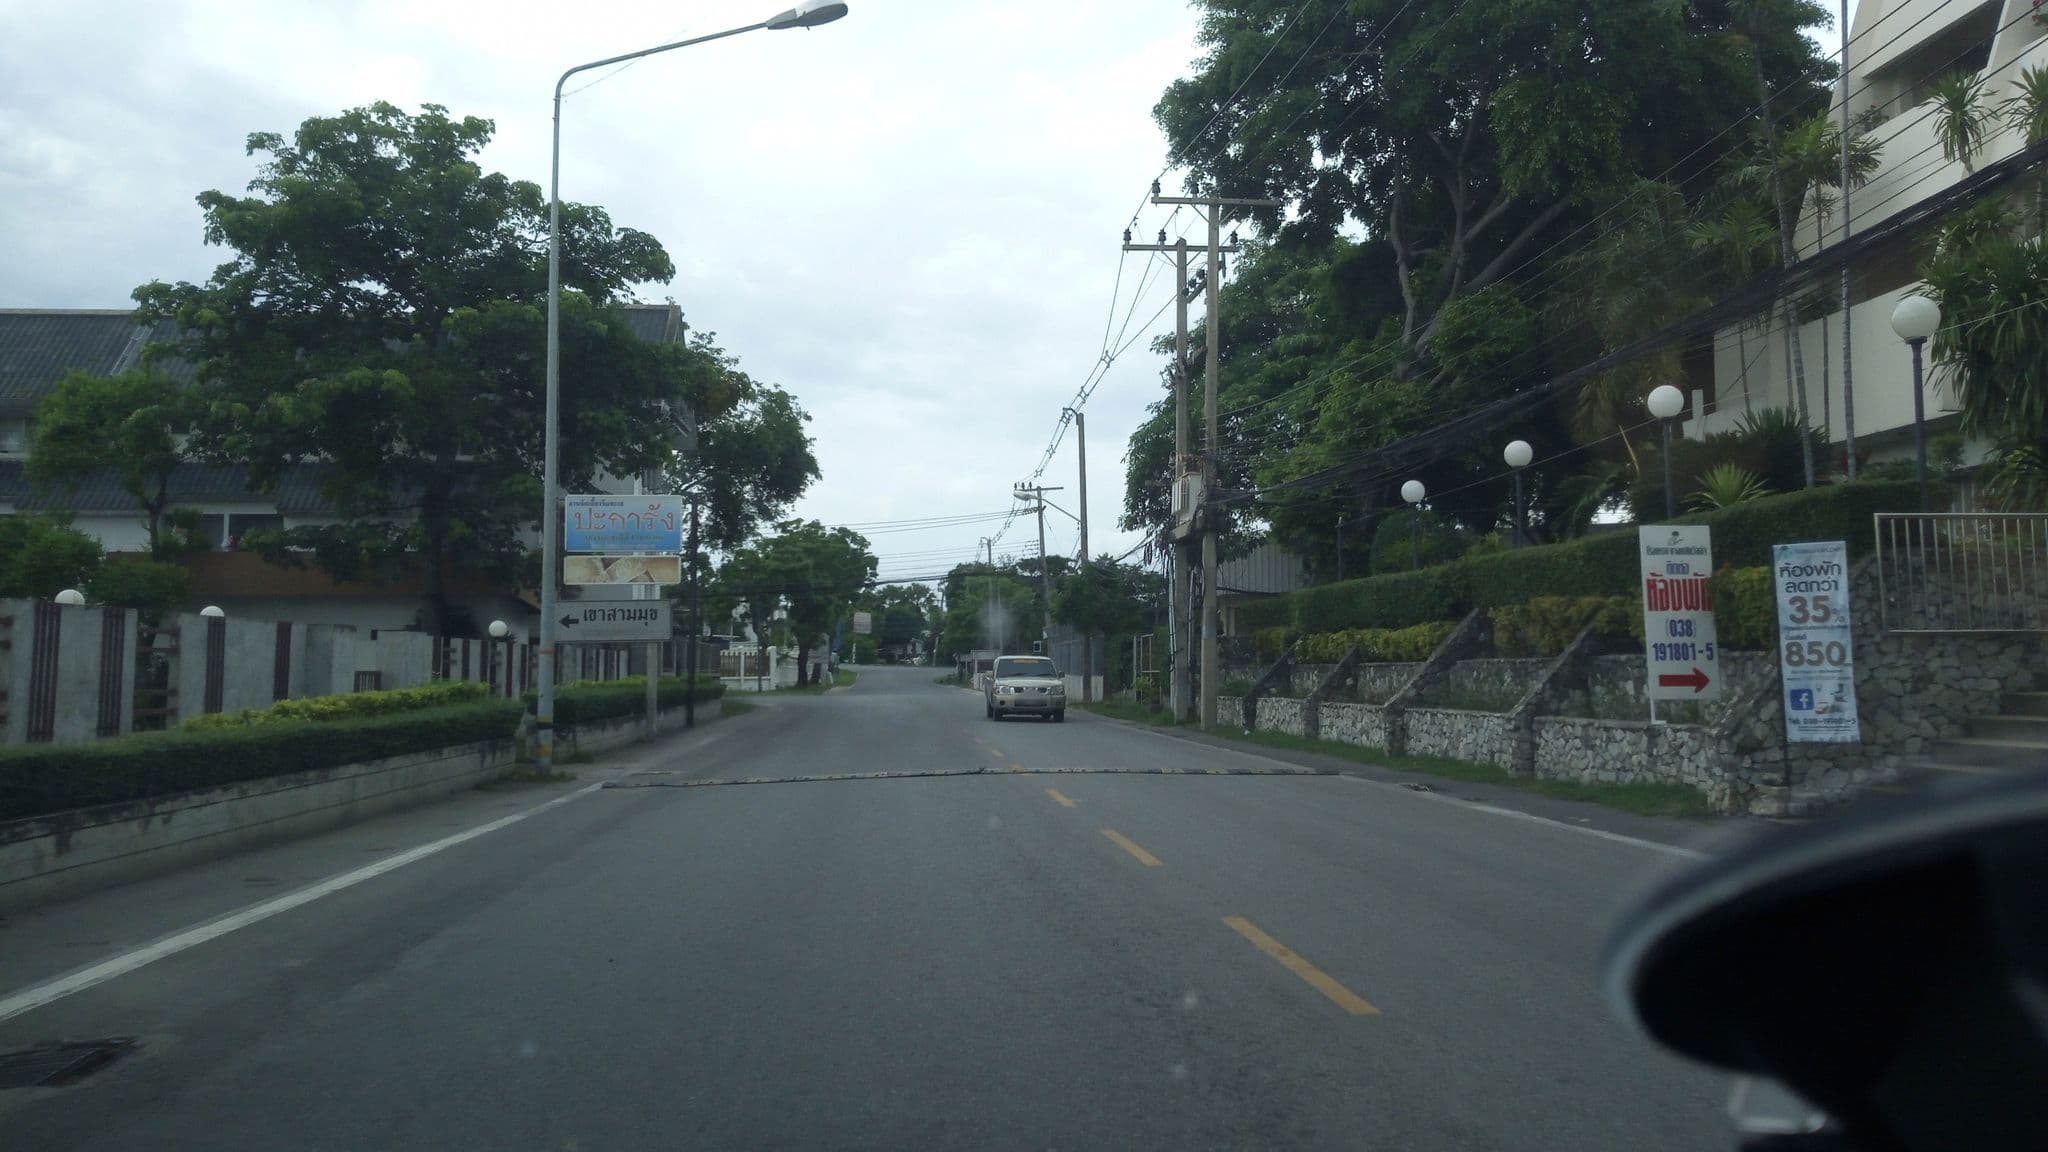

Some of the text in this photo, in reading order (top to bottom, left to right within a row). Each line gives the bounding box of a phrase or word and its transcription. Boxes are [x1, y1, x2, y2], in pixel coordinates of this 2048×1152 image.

[574, 504, 674, 530] ปะการัง
[1779, 561, 1842, 579] ห้องพัก
[1646, 572, 1713, 612] ห้องพัก
[1785, 576, 1839, 593] ลดกว่า
[583, 607, 658, 626] เขาสามมุข
[1652, 642, 1714, 662] 191801-5
[1785, 640, 1846, 667] 850
